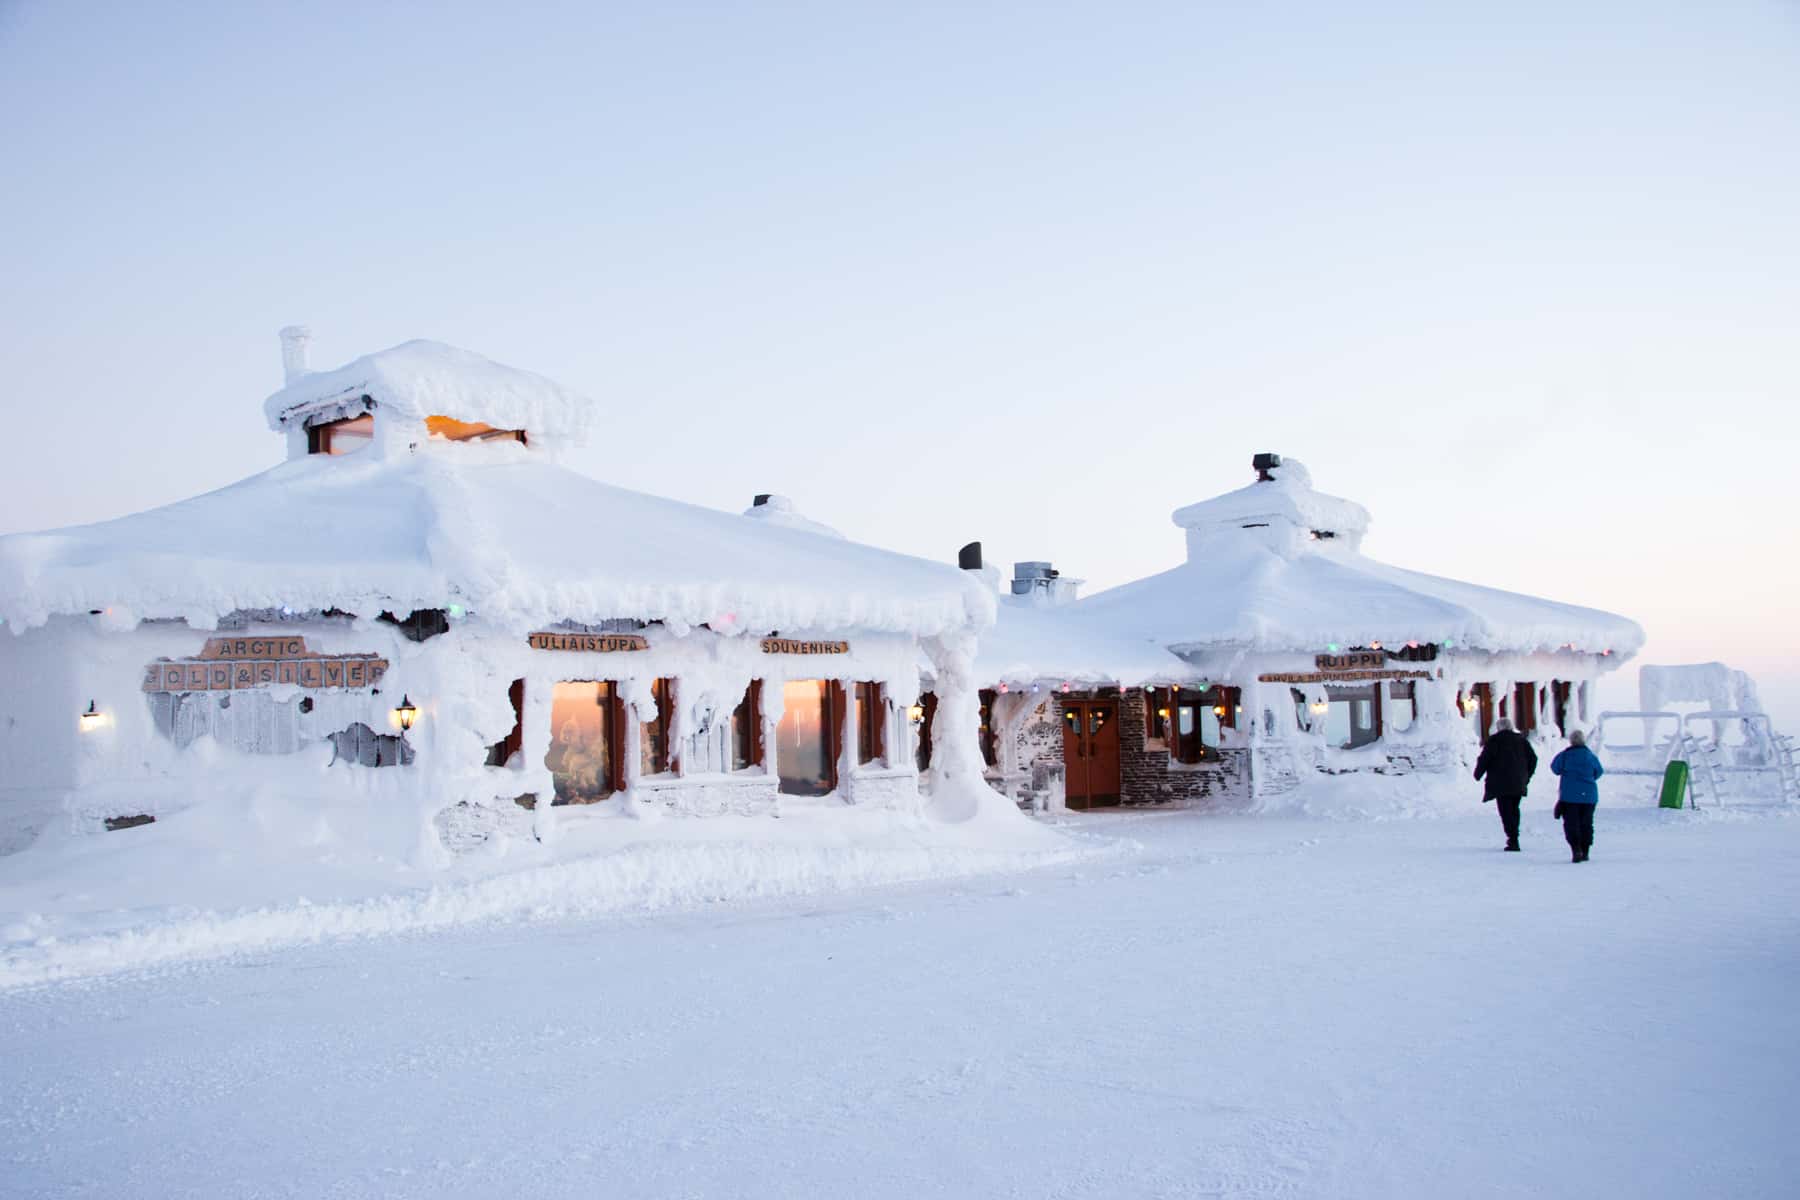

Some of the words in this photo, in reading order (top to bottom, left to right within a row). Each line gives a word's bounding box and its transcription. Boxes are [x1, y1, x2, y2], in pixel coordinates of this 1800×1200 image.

[220, 640, 299, 655] ARCTIC
[762, 641, 841, 654] SOUVENIRS
[1315, 654, 1383, 668] HUIPPU
